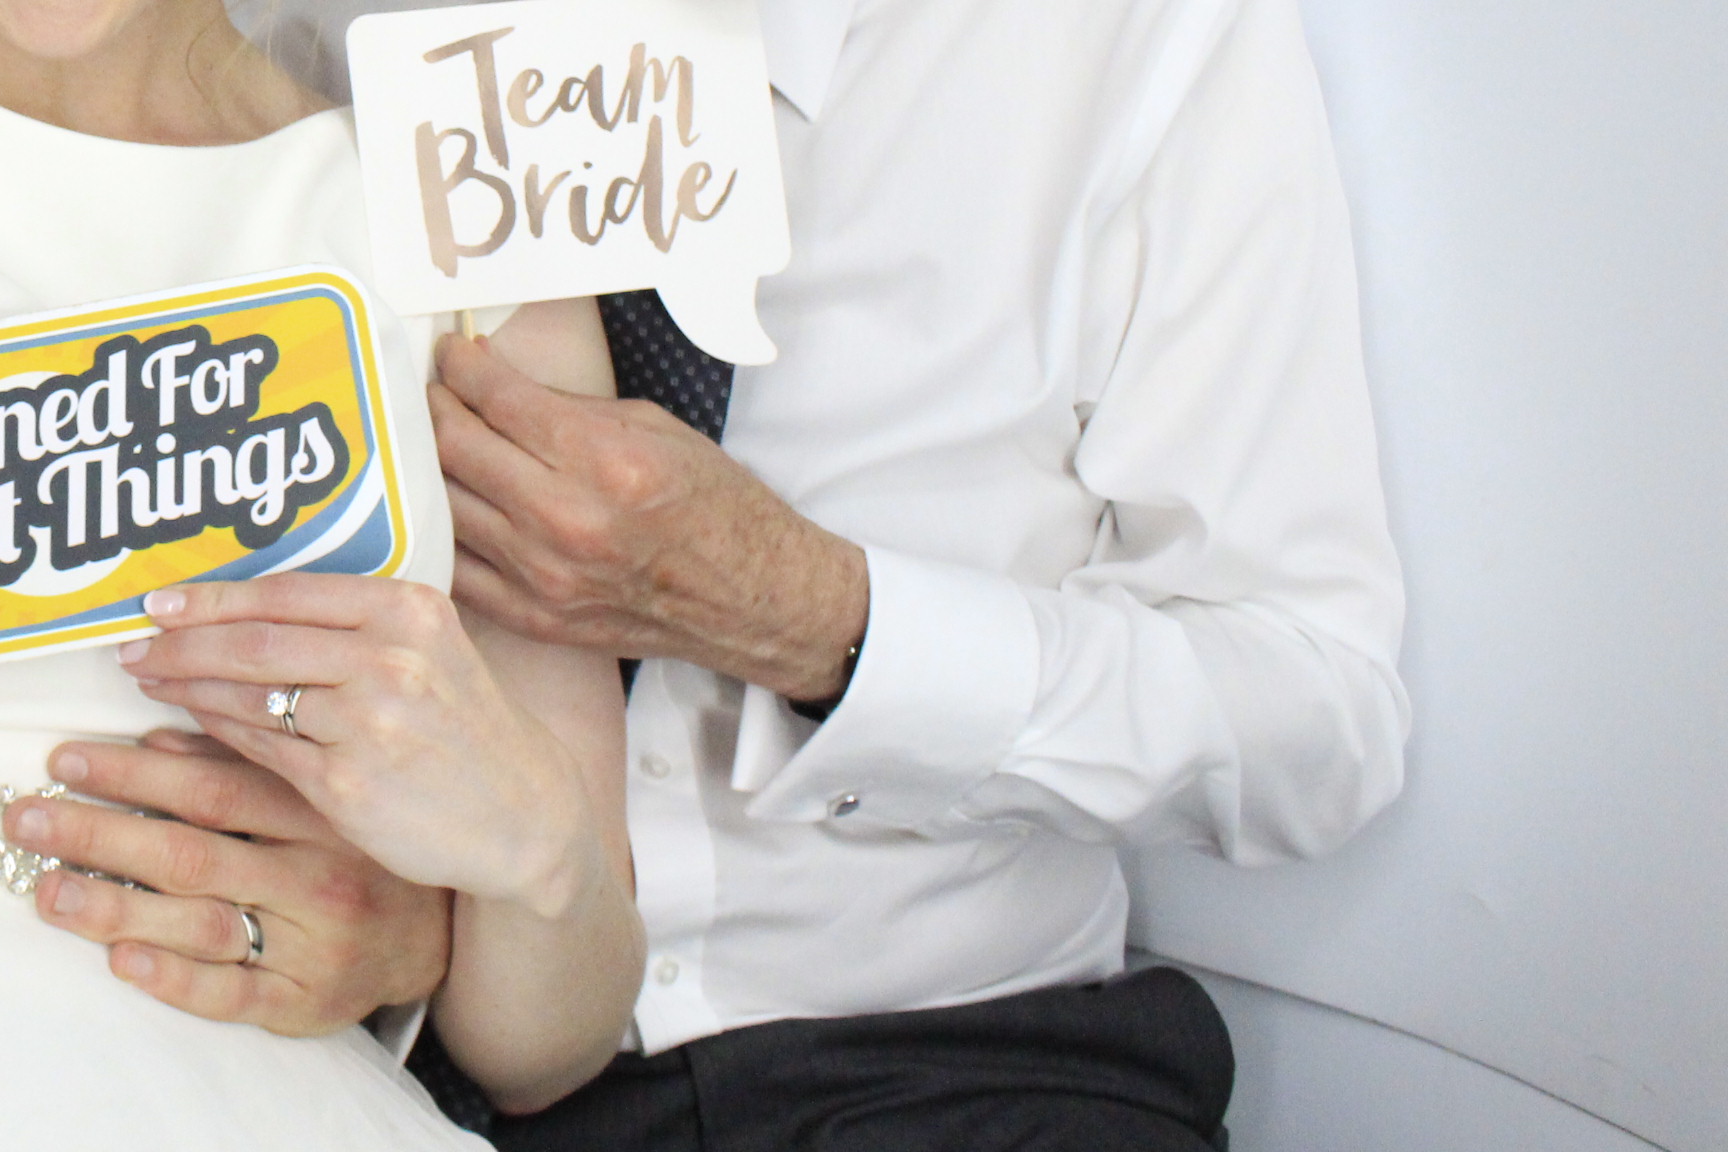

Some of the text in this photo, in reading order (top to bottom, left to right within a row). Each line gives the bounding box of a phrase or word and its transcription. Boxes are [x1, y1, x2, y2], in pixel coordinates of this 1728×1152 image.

[423, 27, 700, 170] Team
[416, 115, 737, 278] Bride
[142, 340, 264, 426] For
[37, 416, 335, 548] Things
